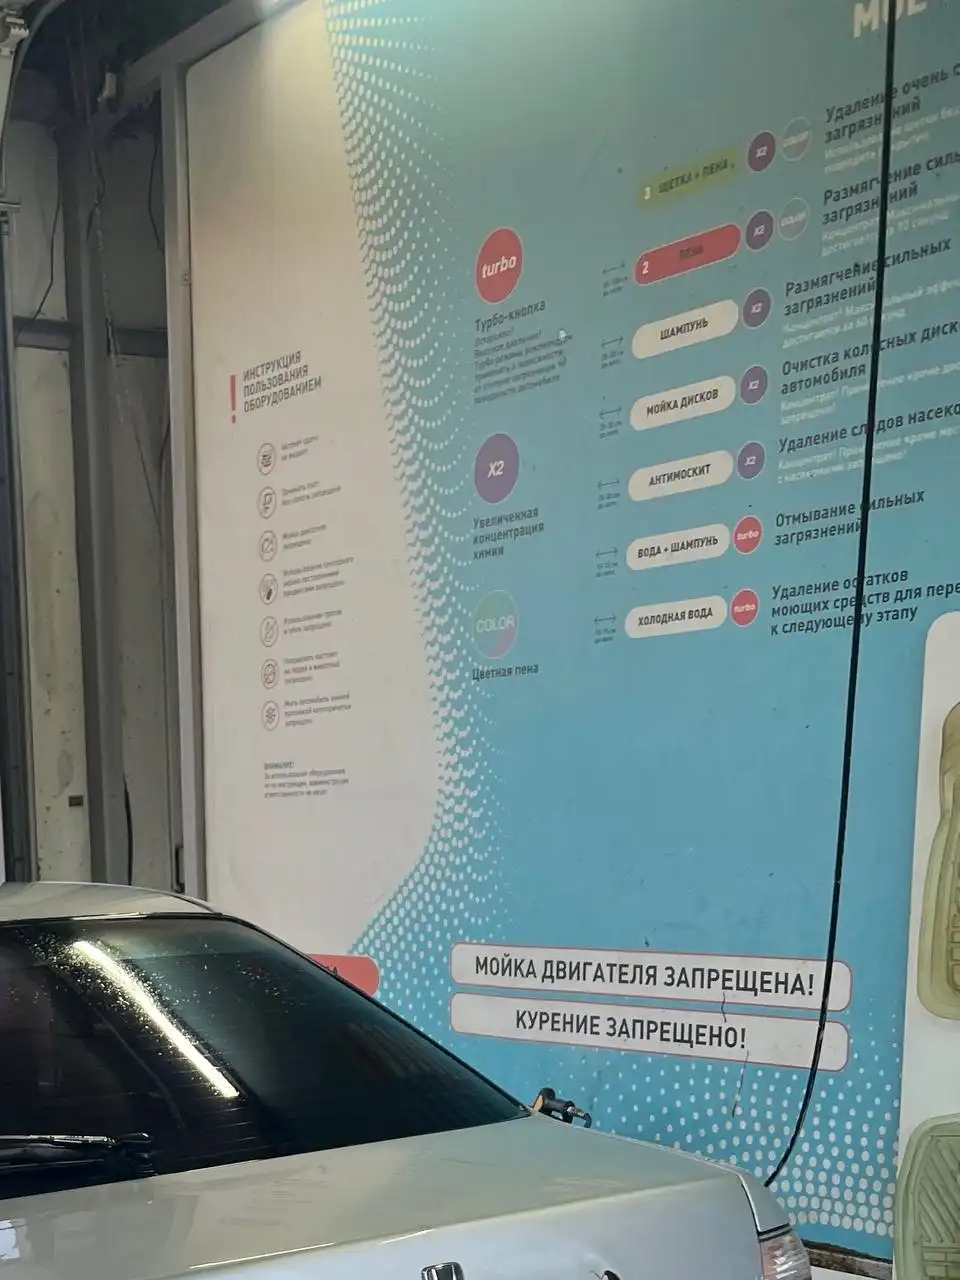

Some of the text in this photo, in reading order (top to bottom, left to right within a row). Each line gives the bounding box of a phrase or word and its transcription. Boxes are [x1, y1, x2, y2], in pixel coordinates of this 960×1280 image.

[902, 69, 948, 95] очень
[824, 96, 921, 144] загрязнний
[822, 180, 918, 225] загрязнний
[481, 256, 517, 279] turbo
[642, 261, 650, 275] 2
[883, 238, 952, 268] сильных
[784, 276, 876, 316] загрязнений
[474, 300, 546, 332] Турбо-кнопка
[660, 317, 709, 340] ШАМПУНЬ
[782, 352, 840, 376] Очистка
[843, 330, 918, 361] колсных
[920, 320, 960, 344] диск
[243, 350, 301, 382] ИНСТРУКЦИЯ
[244, 364, 308, 398] ПОЛЬЗОВАНИЯ
[781, 364, 866, 396] автомобиля
[244, 375, 322, 412] ОБОРУДОВАНИЕМ
[646, 388, 719, 417] МОЙКА ДИСКОВ
[778, 428, 847, 453] Удаление
[851, 416, 904, 436] слдов
[487, 460, 505, 478] X2
[648, 464, 711, 486] АНТИМОСКИТ
[744, 456, 756, 466] X2
[473, 508, 538, 530] Увеличенная
[776, 490, 926, 528] Отмывание ильных
[472, 522, 545, 545] концентрация
[774, 516, 862, 546] загрязнений
[473, 546, 504, 561] химии
[637, 546, 662, 559] ВОДА
[670, 536, 718, 552] ШАМПУНЬ
[772, 570, 908, 600] Удаление осатков
[638, 608, 713, 626] ХОЛОДНАЯ ВОДА
[772, 599, 830, 618] моющих
[894, 586, 922, 603] для
[476, 614, 515, 633] COLOR
[770, 624, 778, 636] к
[876, 606, 918, 622] этапу
[472, 664, 539, 682] Цветная пена
[475, 952, 815, 997] МОЙКА ДВИГАТЕЛЯ ЗАПРЕЩЕНА!
[515, 1008, 746, 1049] КУРЕНИЕ ЗАПРЕЩЕНО!
